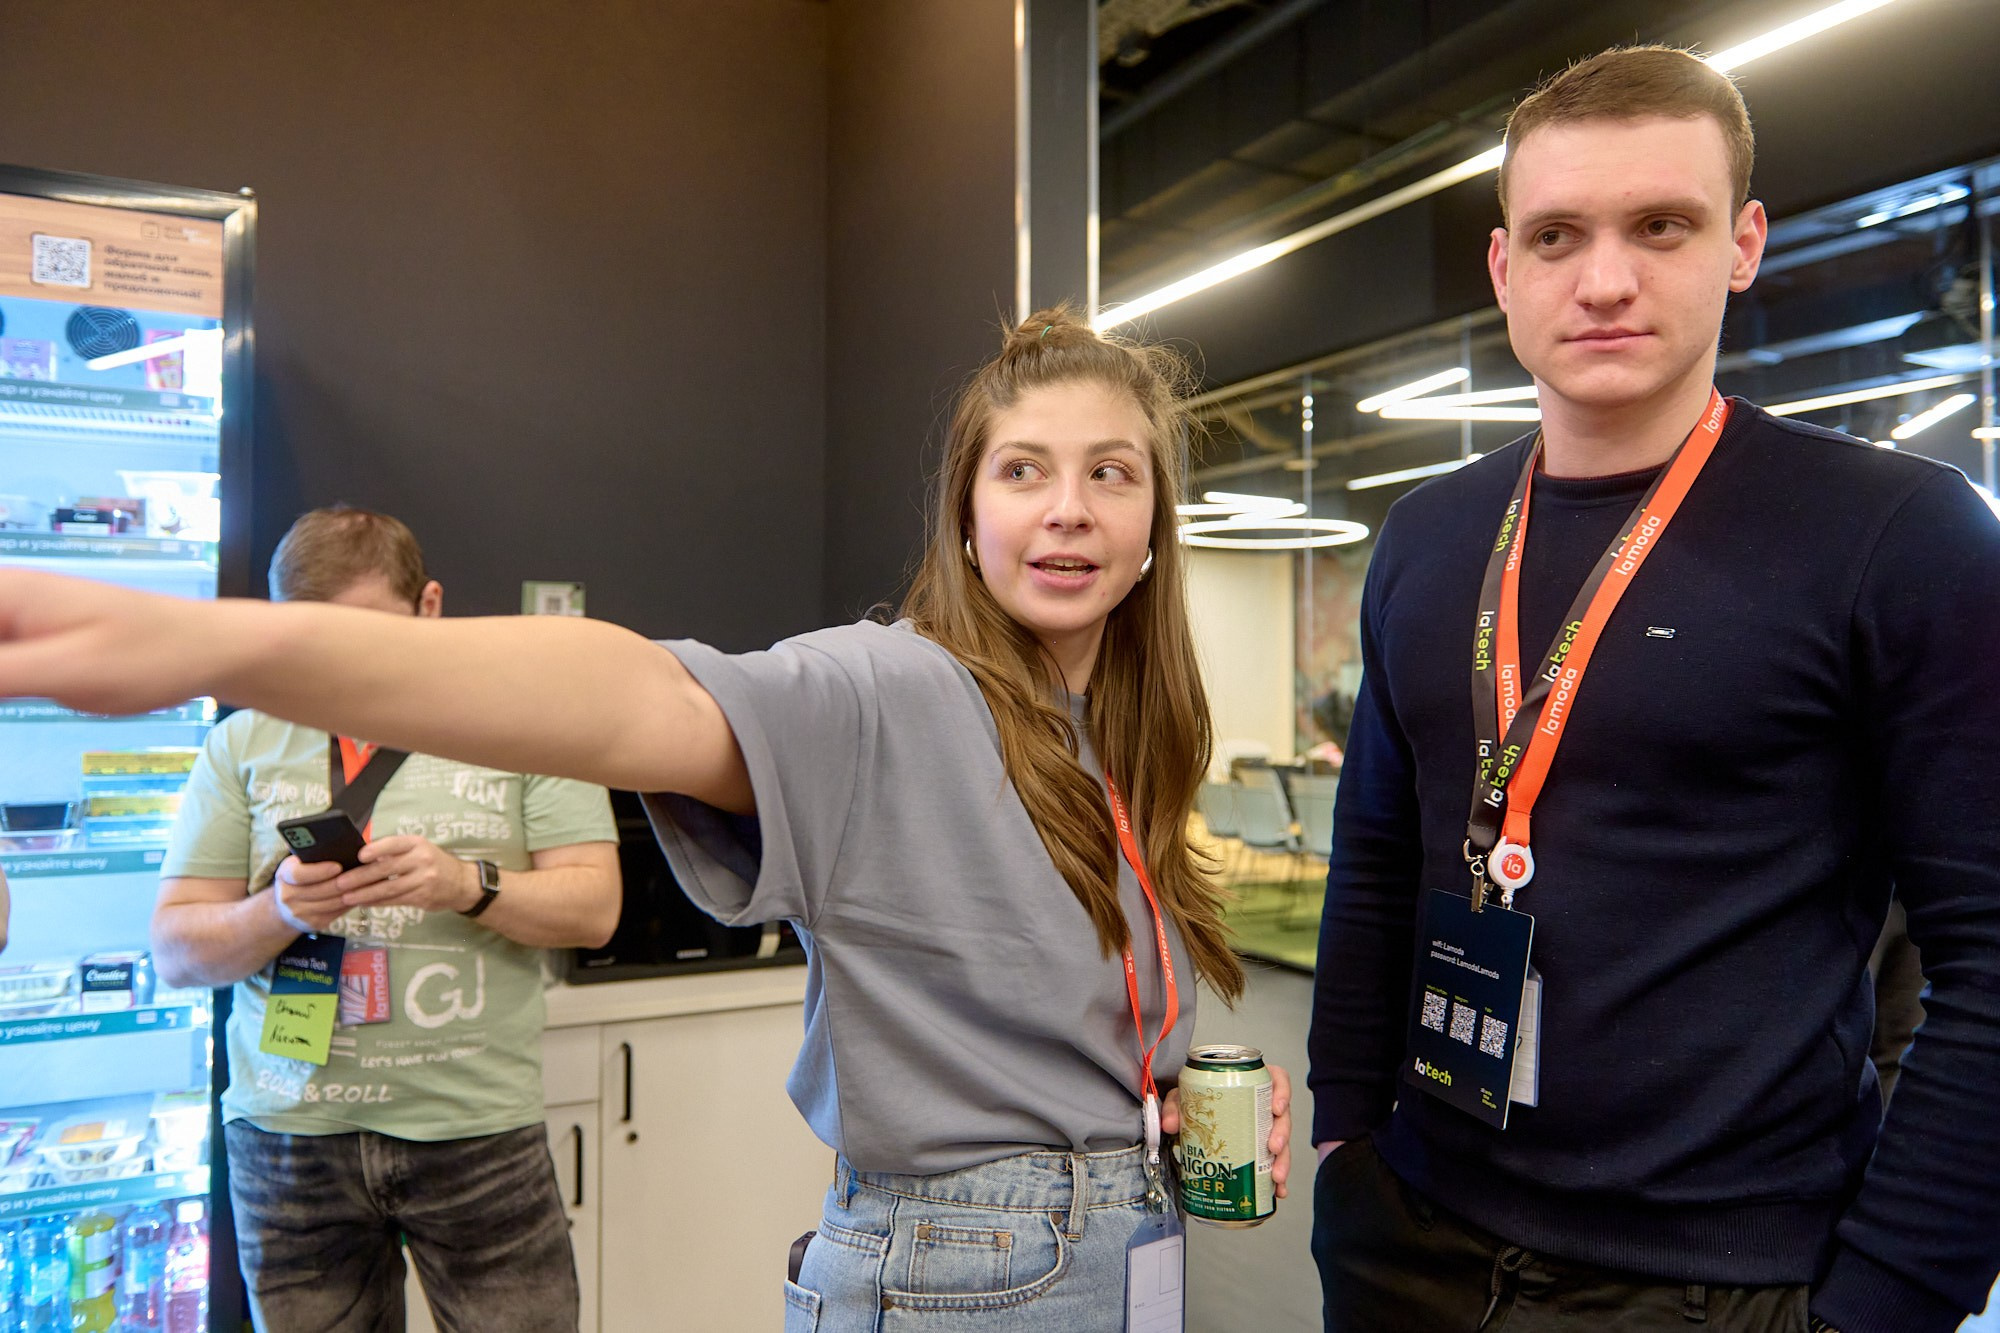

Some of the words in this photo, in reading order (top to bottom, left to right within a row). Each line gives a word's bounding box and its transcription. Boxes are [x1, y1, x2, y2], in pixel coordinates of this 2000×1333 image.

[1496, 499, 1521, 552] latech
[1614, 515, 1662, 576] lamoda
[1476, 611, 1495, 671] latech
[1541, 620, 1582, 683] latech
[1540, 667, 1579, 736] lamoda
[1483, 744, 1521, 808] latech
[435, 820, 512, 840] STRESS
[1507, 858, 1522, 875] la
[1443, 942, 1465, 956] Lamoda
[1457, 958, 1500, 980] LamodaLamoda
[373, 951, 387, 1018] lamoda
[5, 1021, 64, 1040] узнайте
[65, 1019, 101, 1033] цену
[1414, 1057, 1452, 1087] latech
[322, 1082, 393, 1104] ROLL
[1187, 1144, 1206, 1160] BIA
